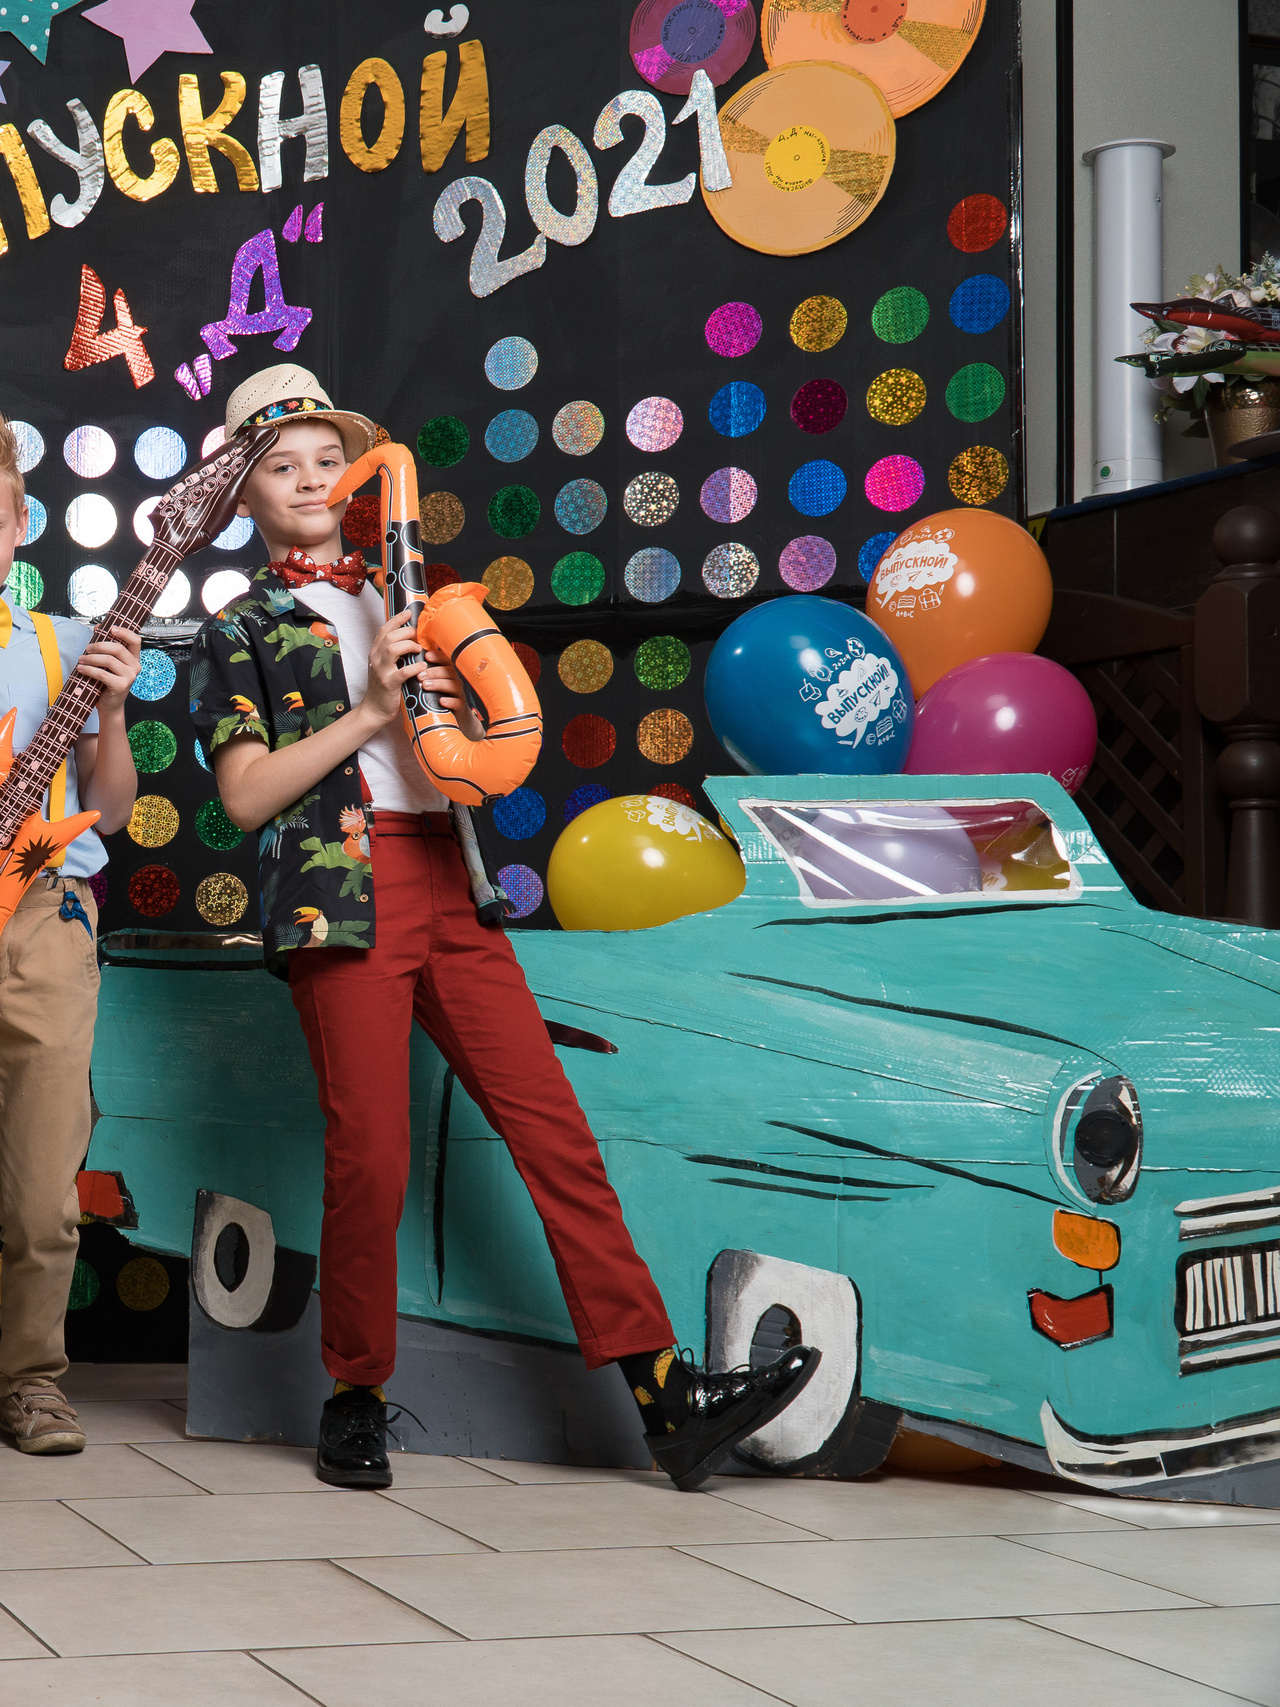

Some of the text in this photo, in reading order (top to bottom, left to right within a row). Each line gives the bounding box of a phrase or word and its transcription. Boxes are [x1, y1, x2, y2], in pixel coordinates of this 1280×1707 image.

[433, 68, 733, 299] 2021
[63, 264, 156, 390] 4
[880, 553, 949, 581] ВЫПУСКНОЙ!
[827, 662, 890, 725] ВЫПУСКНОЙ!
